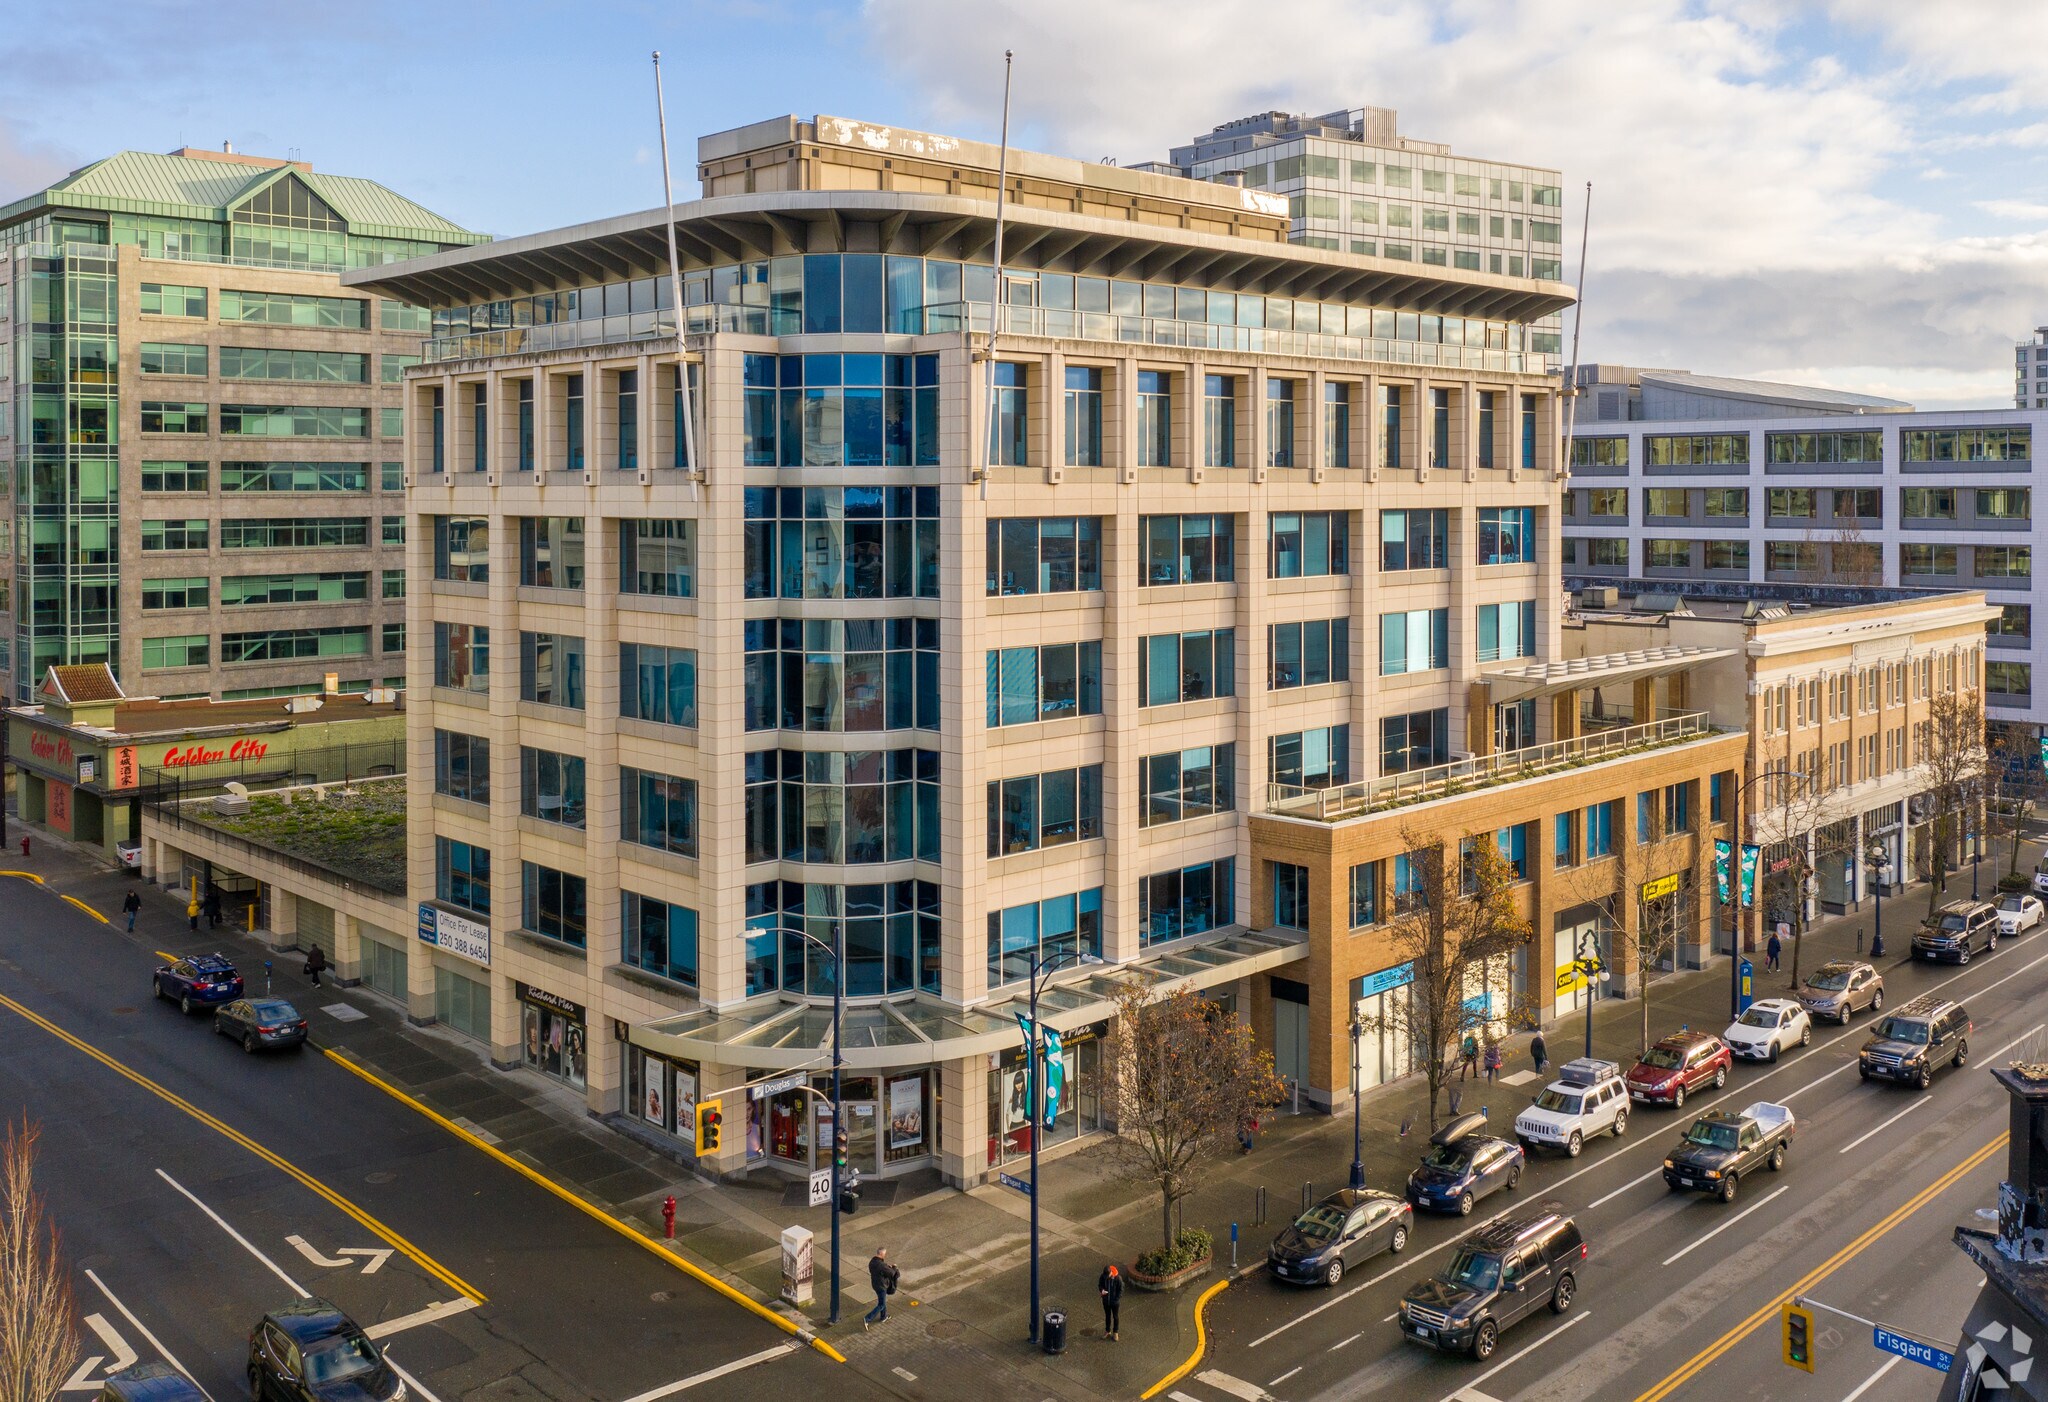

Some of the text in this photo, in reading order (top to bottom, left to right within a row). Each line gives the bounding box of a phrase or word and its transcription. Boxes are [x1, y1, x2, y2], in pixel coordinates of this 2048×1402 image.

[31, 730, 73, 767] Golden City
[163, 739, 267, 768] Golden City
[440, 914, 487, 941] Office For Lease
[439, 932, 453, 948] 250
[454, 938, 468, 953] 388
[469, 943, 487, 961] 6454
[764, 1079, 790, 1094] Douglas
[812, 1178, 830, 1195] 40
[1878, 1331, 1951, 1363] Fisgard St.
